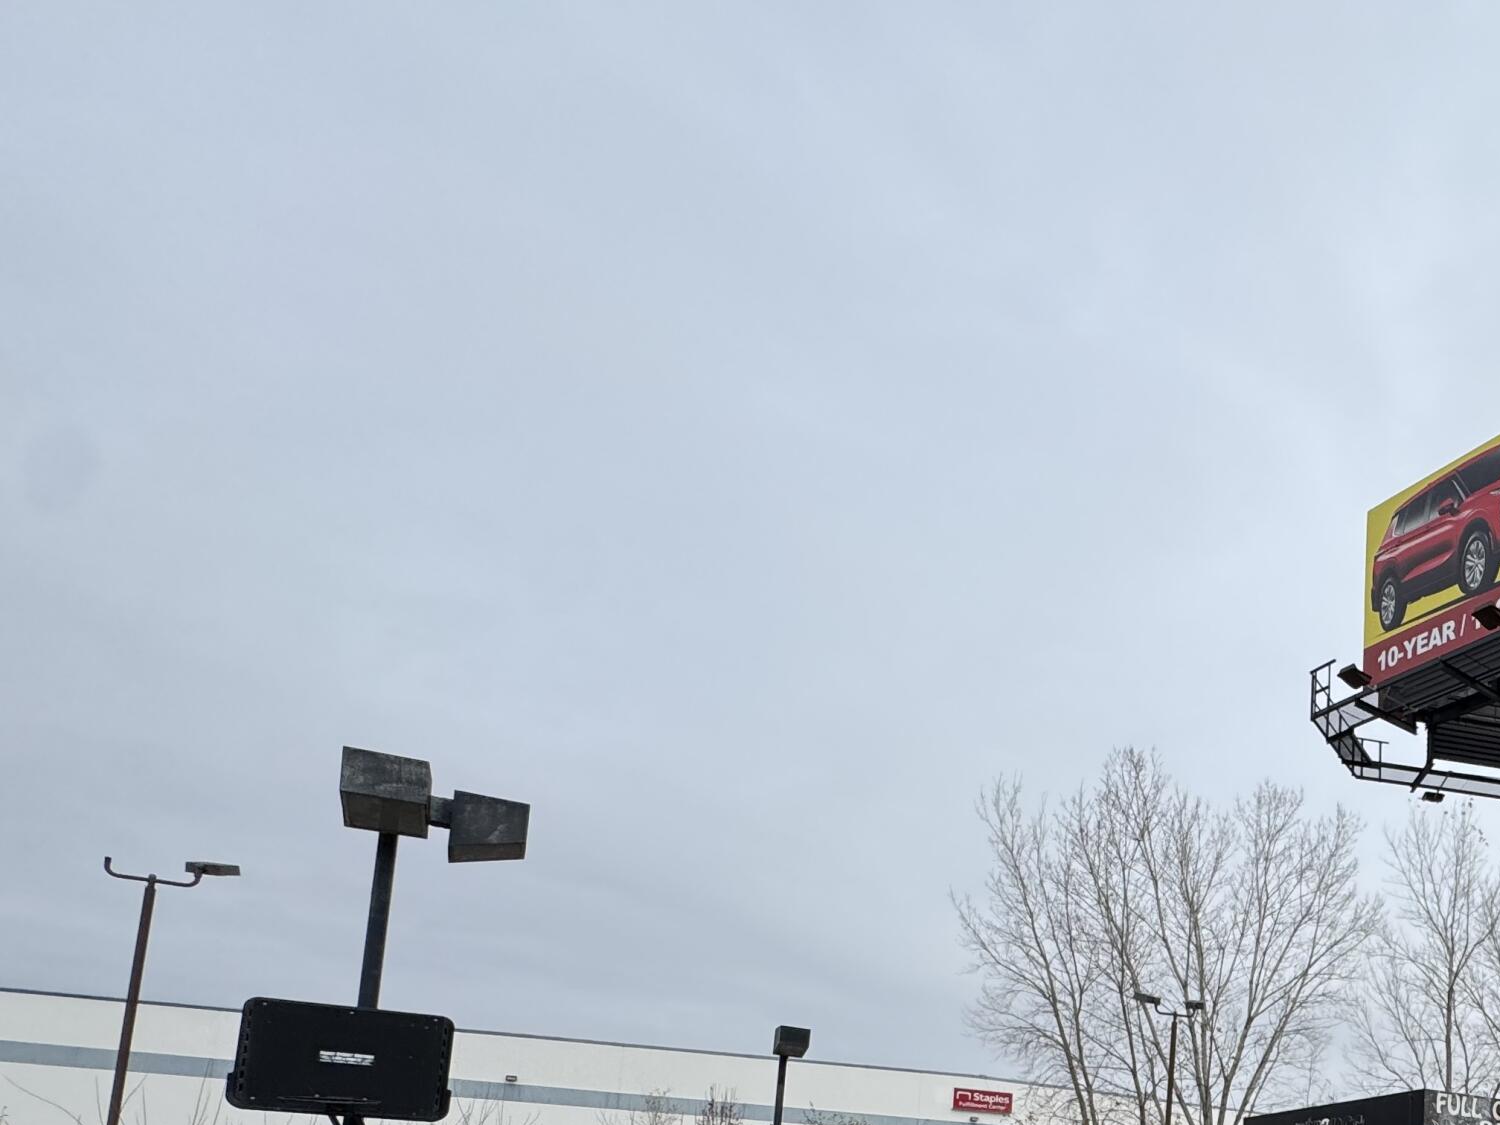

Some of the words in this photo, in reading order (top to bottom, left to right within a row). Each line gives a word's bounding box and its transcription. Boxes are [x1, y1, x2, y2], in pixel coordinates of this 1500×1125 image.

[1376, 618, 1457, 673] 10-YEAR
[973, 1092, 1010, 1104] Staples
[1435, 1092, 1483, 1120] FULL
